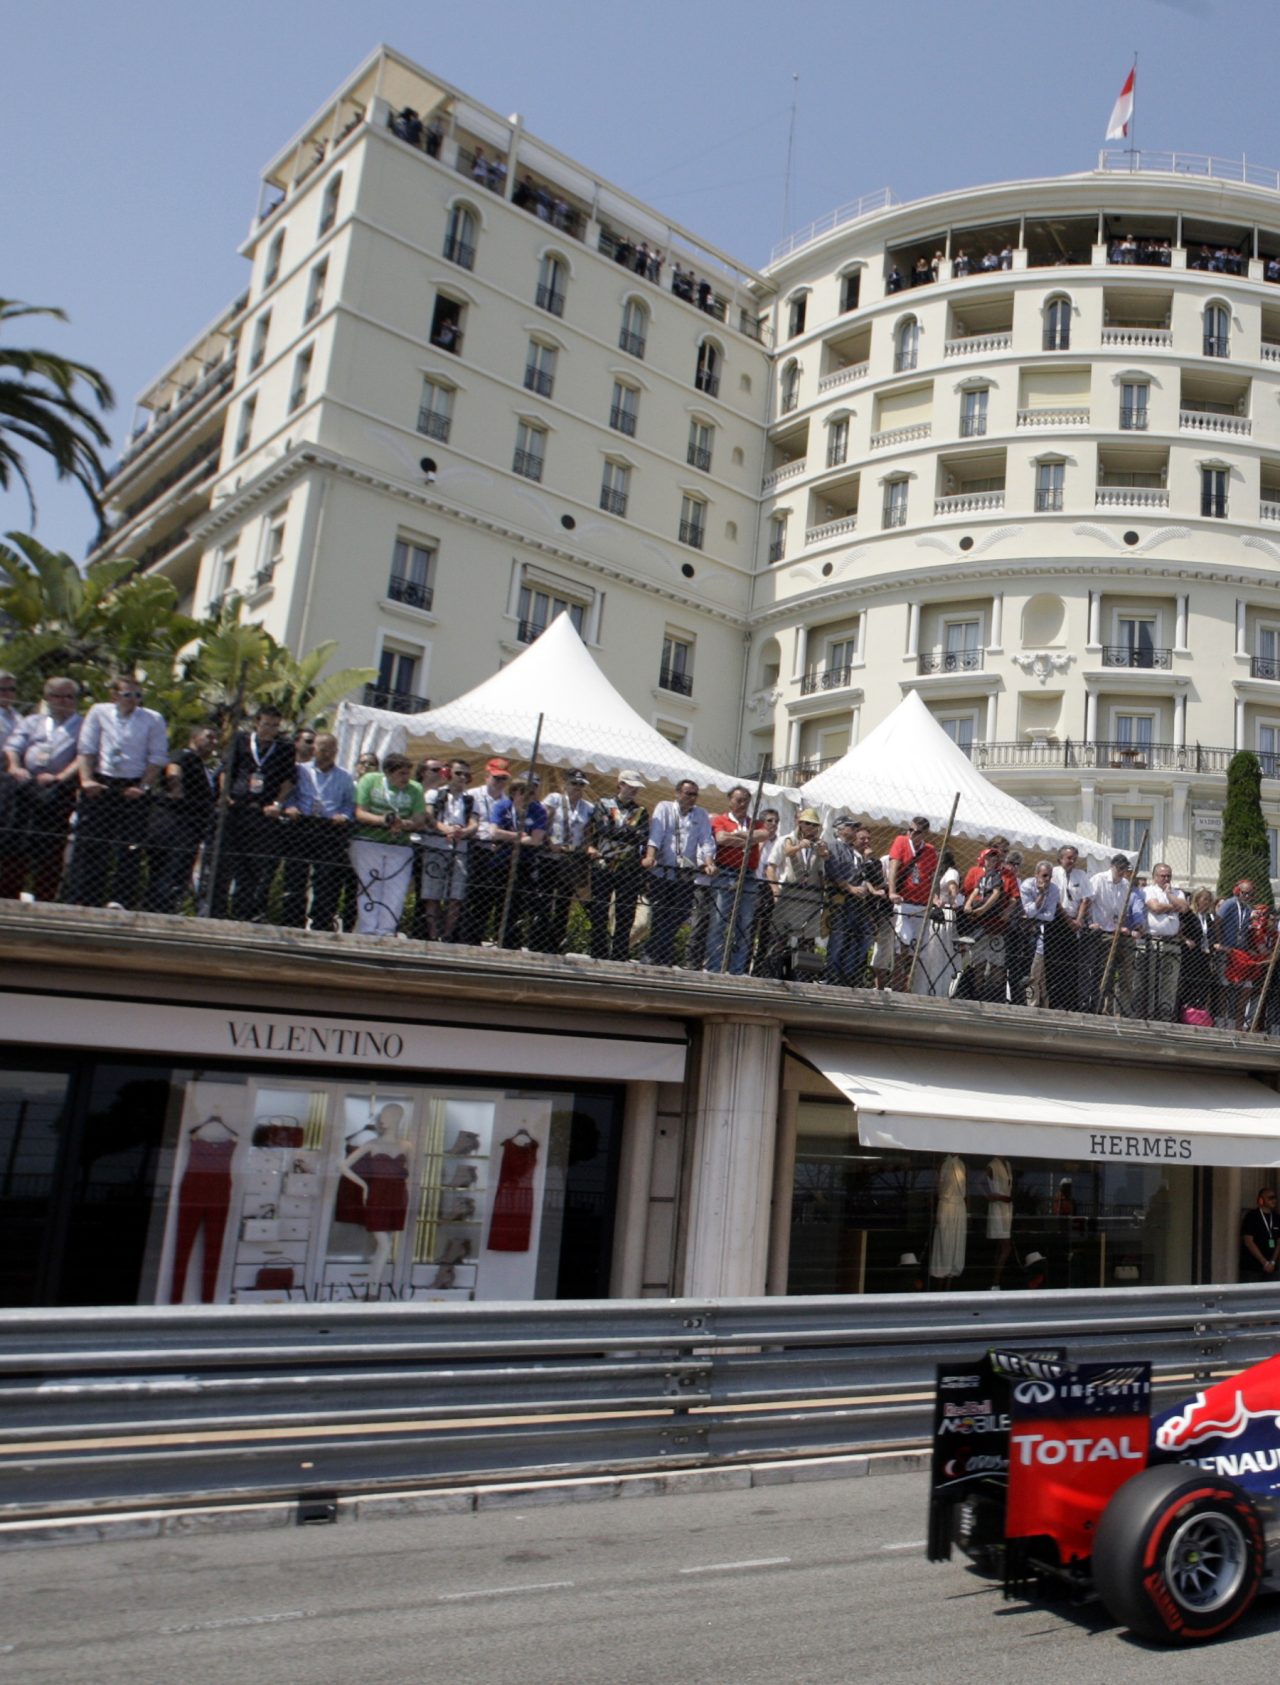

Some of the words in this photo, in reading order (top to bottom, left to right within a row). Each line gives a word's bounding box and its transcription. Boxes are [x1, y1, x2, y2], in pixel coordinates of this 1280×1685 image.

[227, 1020, 404, 1059] VALENTINO
[1089, 1134, 1193, 1159] HERMÈS
[1011, 1434, 1145, 1466] TOTAL
